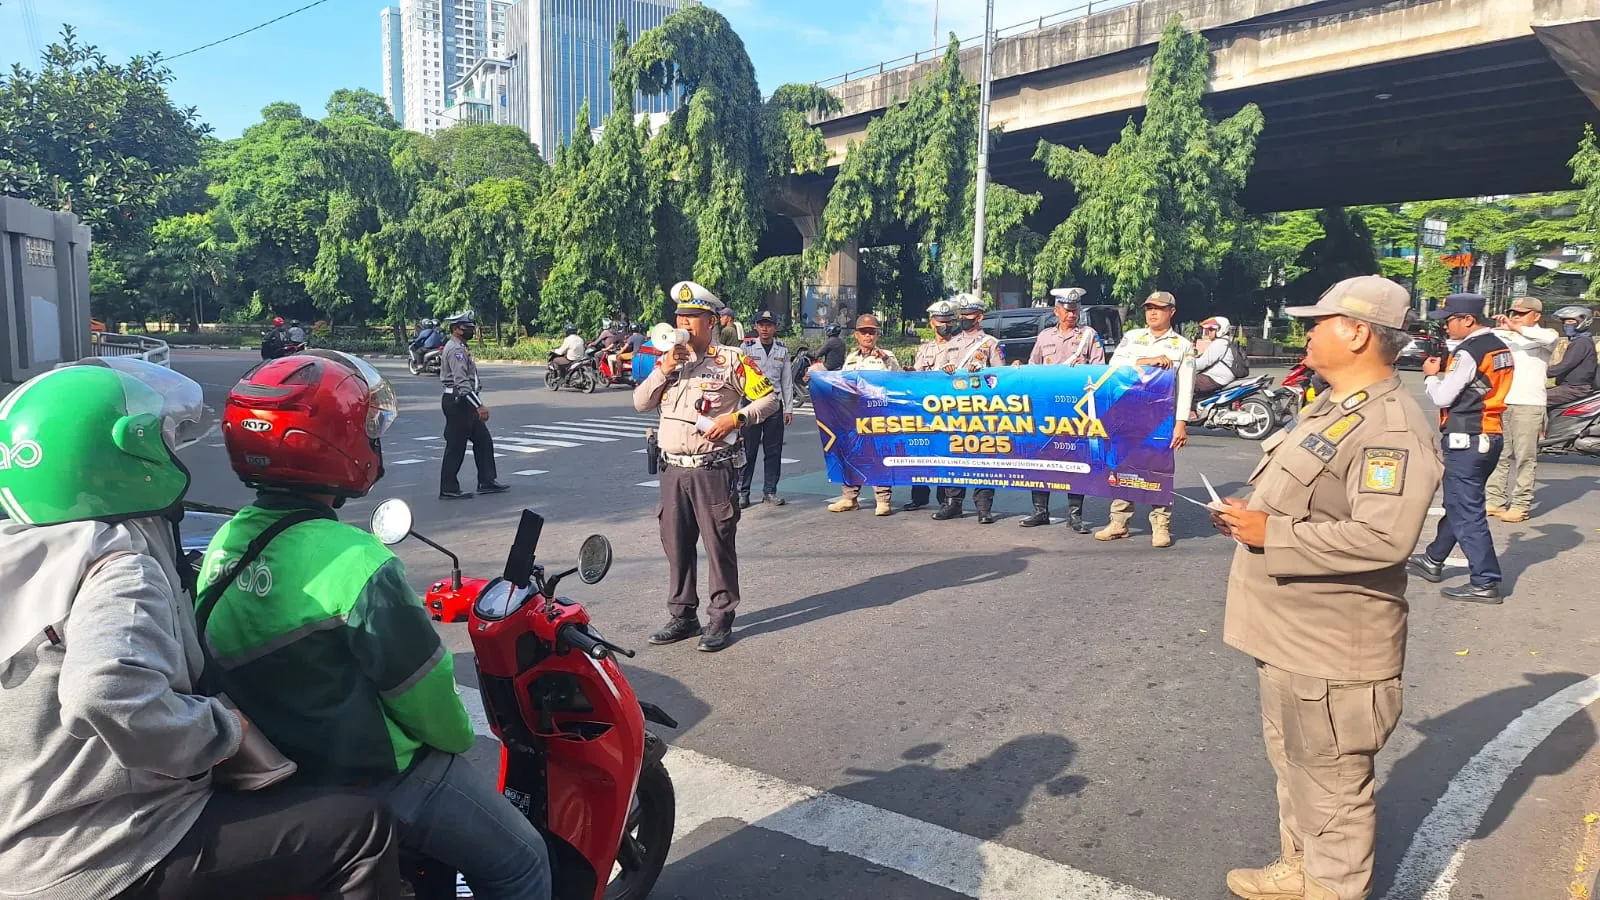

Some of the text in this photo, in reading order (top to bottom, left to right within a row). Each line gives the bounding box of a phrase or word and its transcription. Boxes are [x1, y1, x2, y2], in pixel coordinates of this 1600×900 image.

[922, 394, 1031, 414] OPERASI
[243, 420, 268, 430] KYT
[856, 415, 1110, 439] KESELAMATAN JAYA
[949, 435, 1012, 454] 2025
[911, 476, 1071, 490] SATLANTAS METROPOLITAN JAKARTA TIMUR
